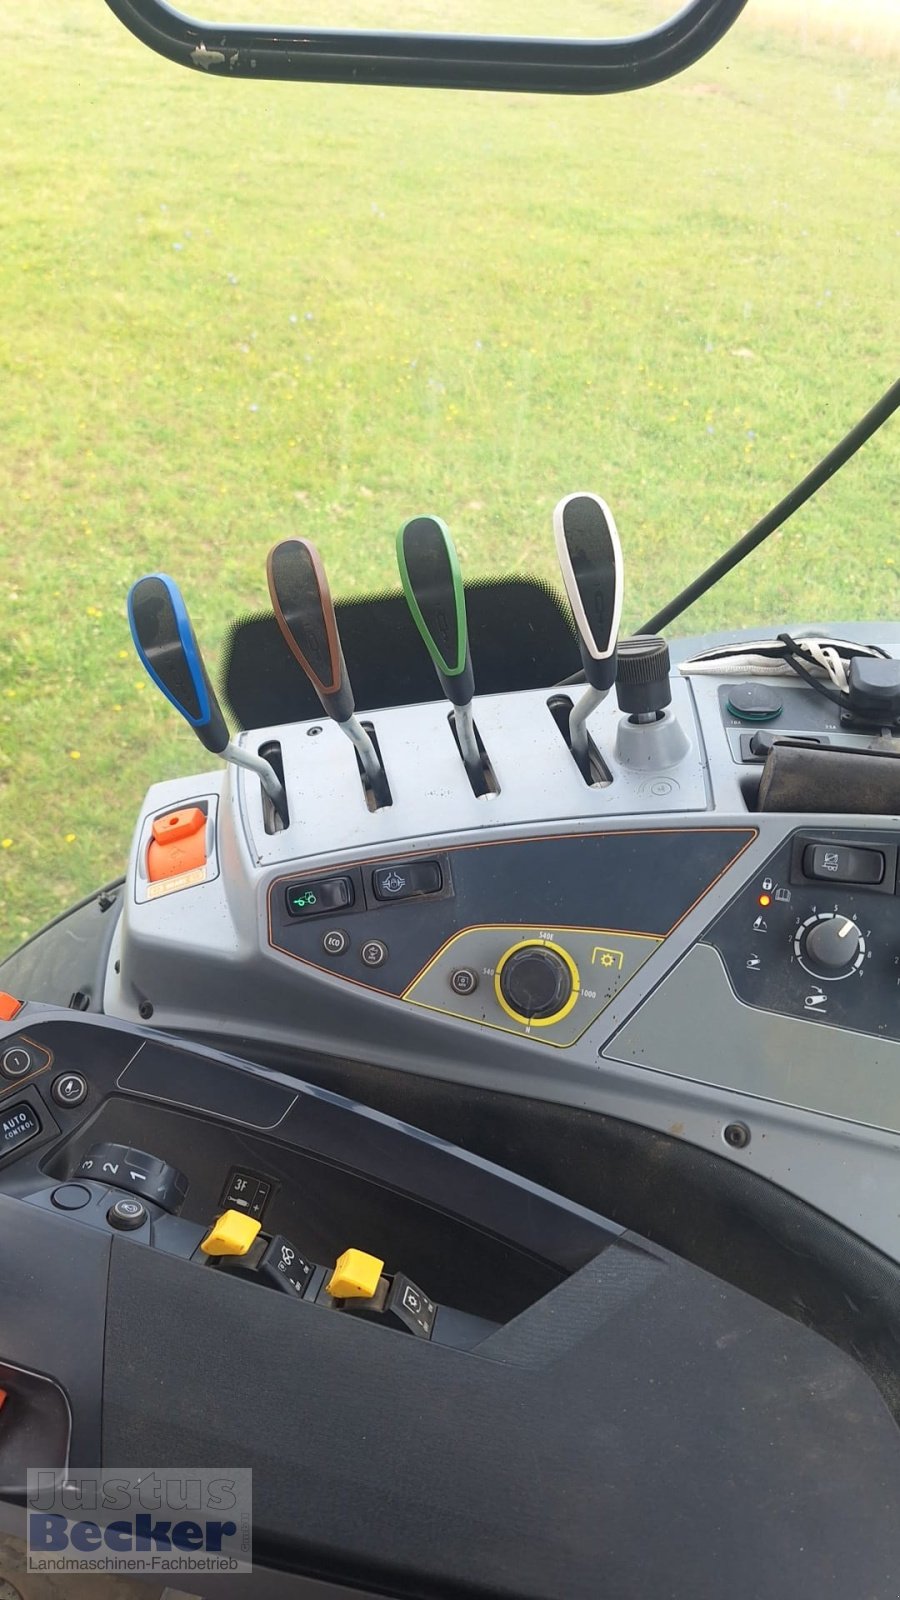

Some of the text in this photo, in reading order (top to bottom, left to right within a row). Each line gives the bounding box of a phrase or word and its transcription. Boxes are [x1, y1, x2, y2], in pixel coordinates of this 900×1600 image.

[811, 905, 817, 913] 4
[834, 904, 839, 912] 5
[795, 917, 801, 925] 3
[788, 935, 793, 943] 2
[866, 930, 872, 938] 7
[328, 937, 341, 947] ECO
[581, 988, 597, 999] 1000
[14, 1057, 20, 1066] 1
[3, 1113, 26, 1132] AUTO
[4, 1121, 34, 1140] CONTROL
[82, 1160, 94, 1170] 3
[102, 1162, 119, 1174] 2
[129, 1170, 147, 1180] 1
[234, 1178, 248, 1192] 3F
